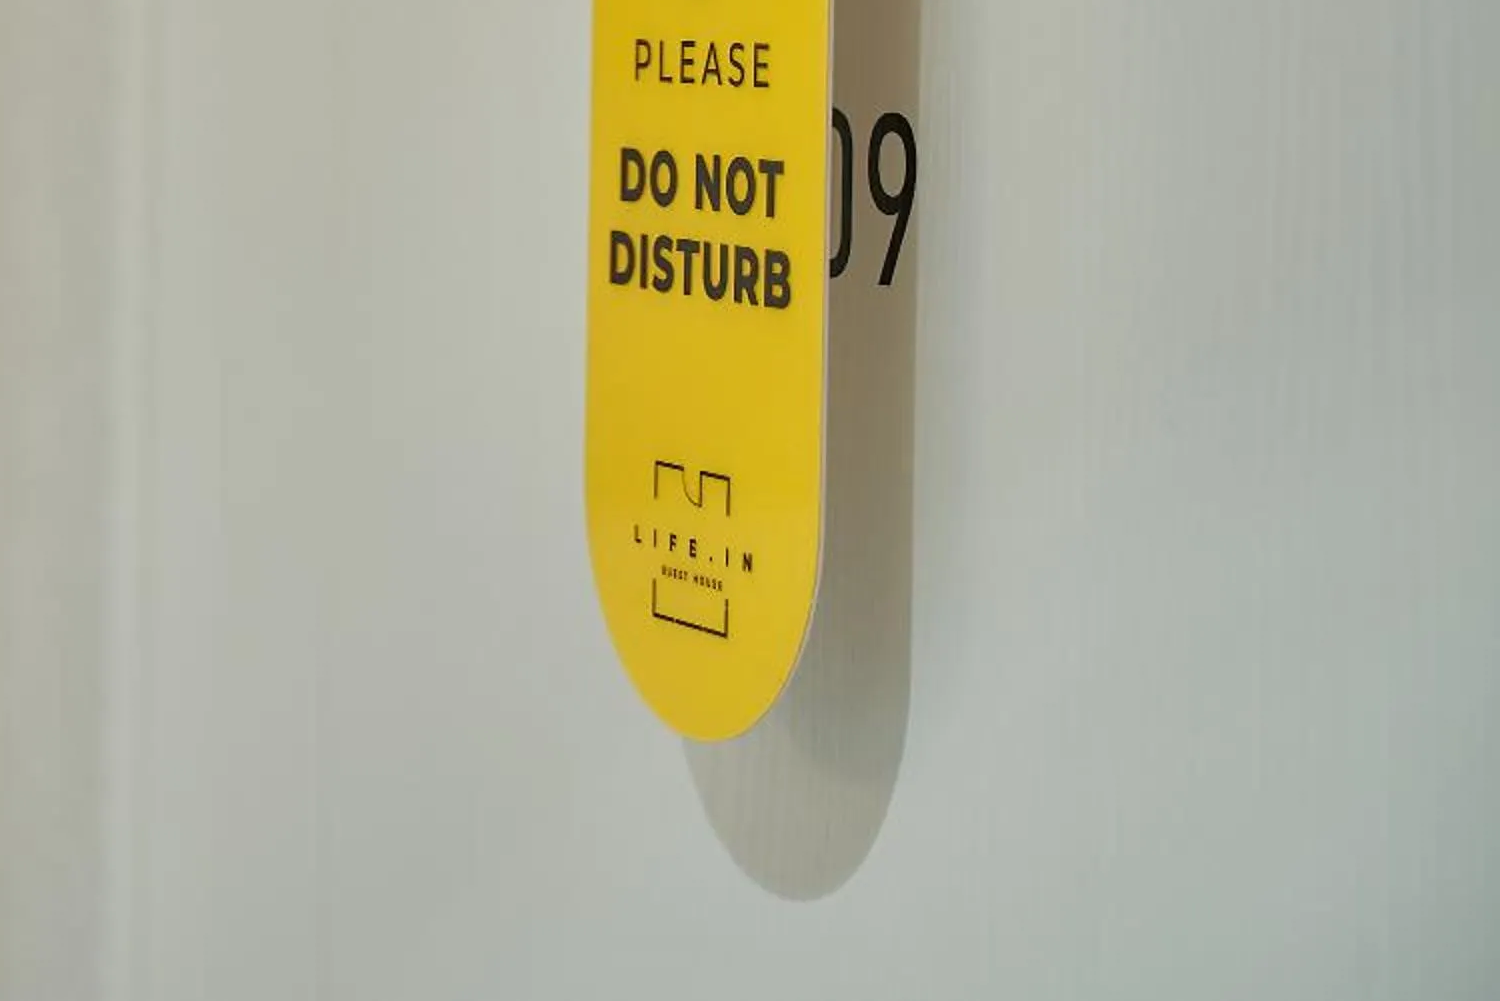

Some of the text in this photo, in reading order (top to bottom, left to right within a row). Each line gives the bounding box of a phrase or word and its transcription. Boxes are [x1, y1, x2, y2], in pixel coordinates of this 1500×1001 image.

[634, 38, 770, 88] PLEASE
[619, 147, 785, 218] DO NOT
[609, 230, 792, 310] DISTURB
